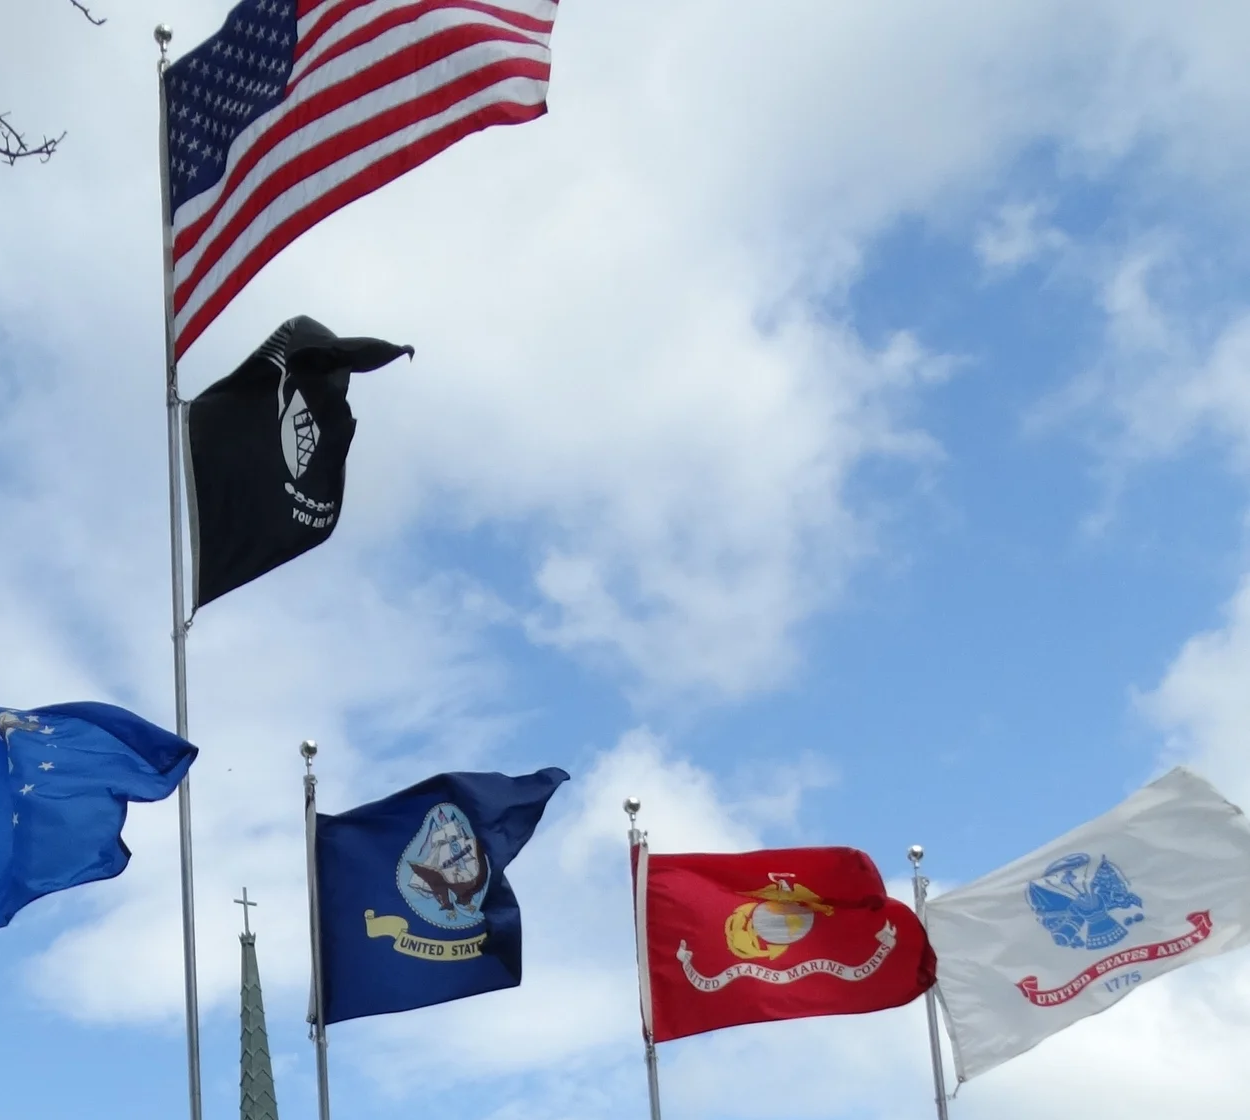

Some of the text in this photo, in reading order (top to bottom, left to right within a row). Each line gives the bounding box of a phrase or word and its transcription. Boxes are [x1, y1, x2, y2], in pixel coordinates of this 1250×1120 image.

[292, 507, 312, 526] YOU
[400, 936, 444, 956] UNITED
[725, 965, 781, 982] STATES
[787, 959, 845, 981] MARINE
[853, 943, 892, 979] CORPS
[1035, 931, 1204, 1005] UNITED STATES ARMY
[1103, 970, 1142, 993] 1775
